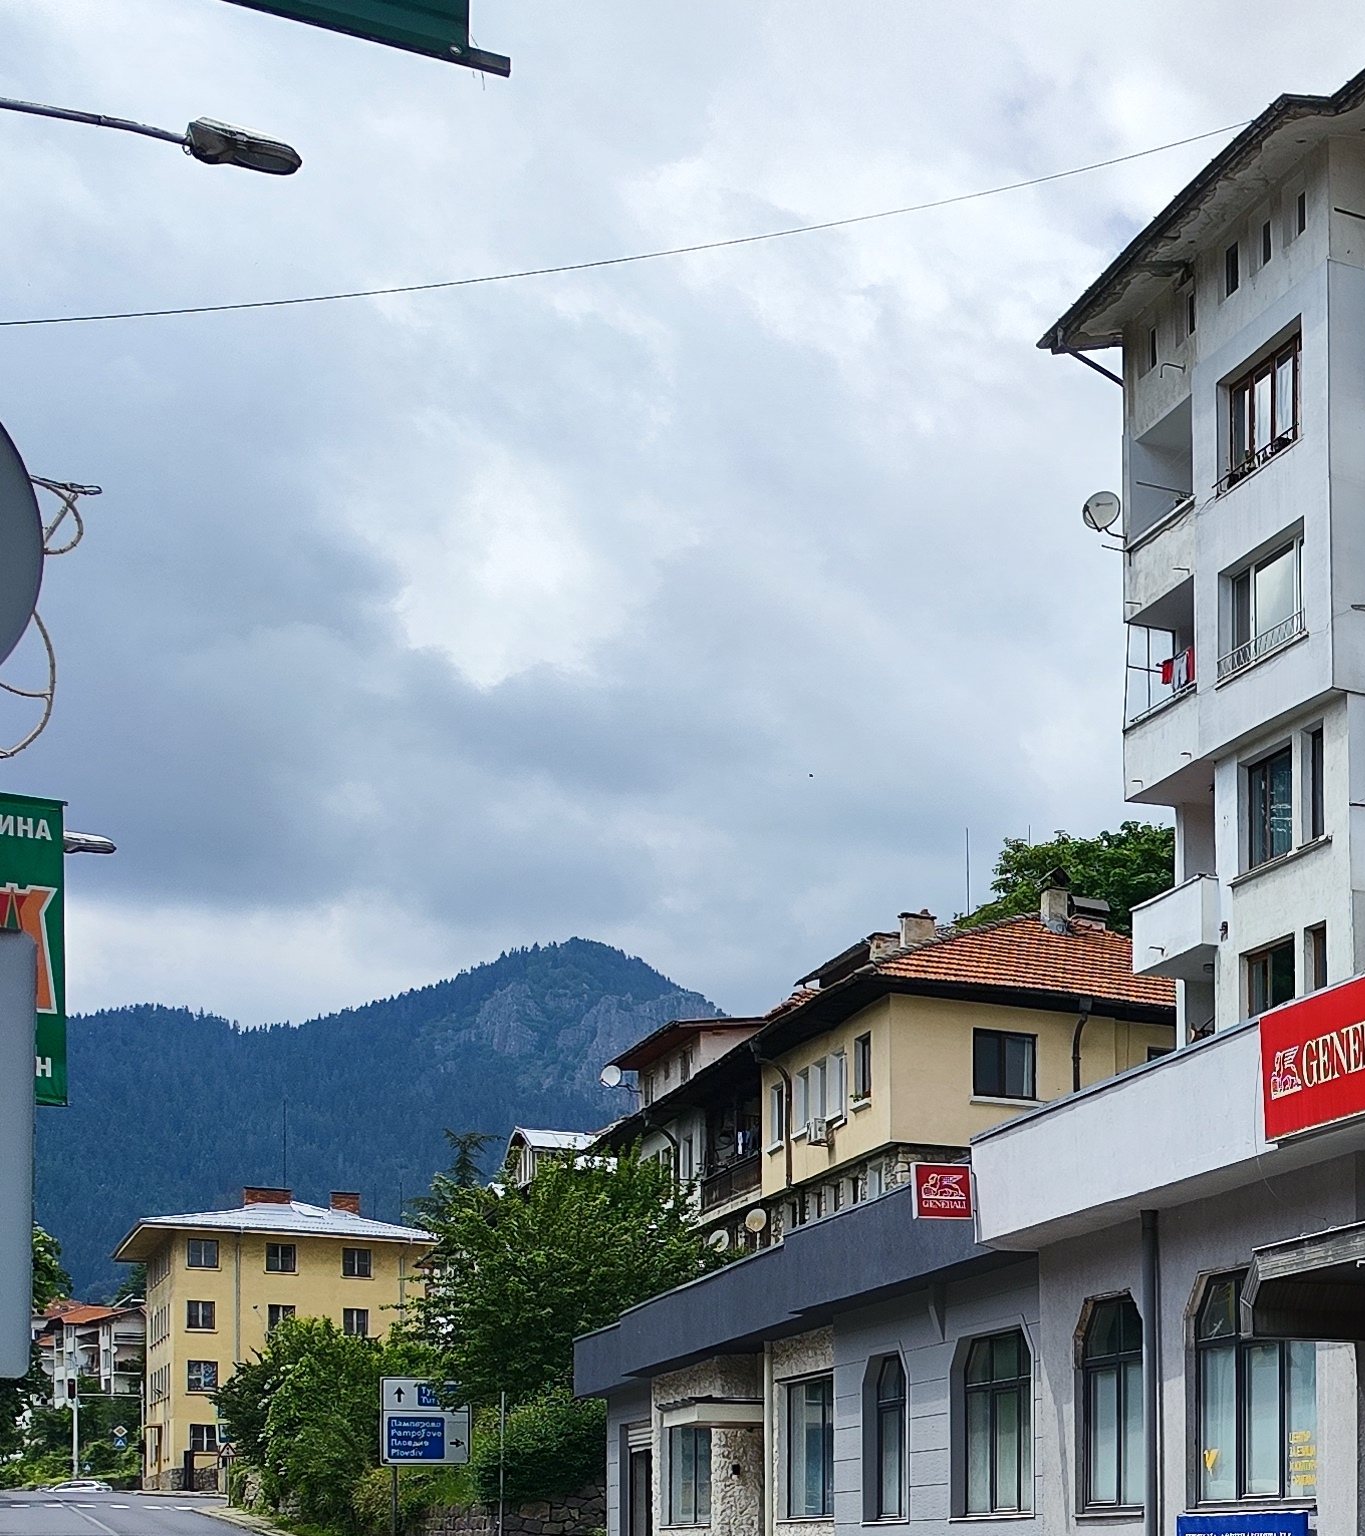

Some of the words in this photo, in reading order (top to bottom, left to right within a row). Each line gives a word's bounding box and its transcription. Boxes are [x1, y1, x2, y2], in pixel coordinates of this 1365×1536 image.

[0, 814, 52, 841] ИНА
[922, 1200, 966, 1209] GENERALI
[391, 1449, 423, 1457] Plovdiv
